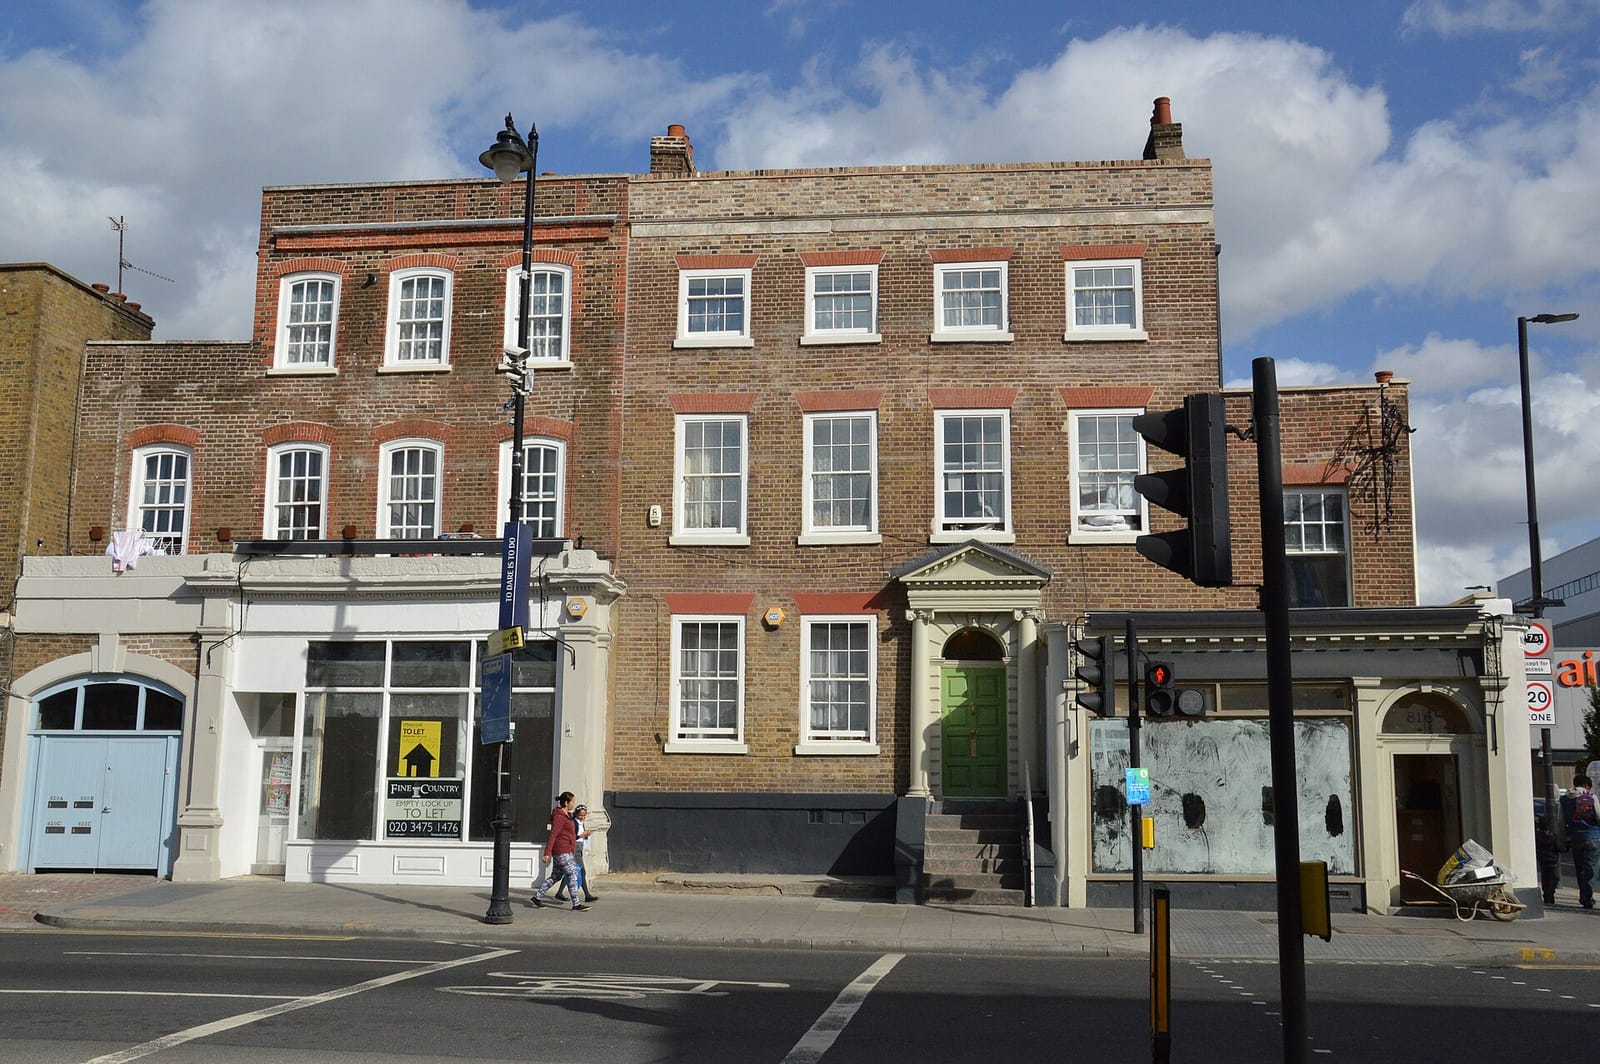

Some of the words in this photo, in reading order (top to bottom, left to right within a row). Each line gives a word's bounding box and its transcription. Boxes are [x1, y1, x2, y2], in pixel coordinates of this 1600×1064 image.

[508, 537, 516, 549] DO
[508, 550, 515, 560] TO
[507, 561, 515, 569] IS
[506, 570, 514, 591] DARE
[505, 592, 513, 602] TO
[1555, 649, 1600, 688] ai
[1527, 691, 1548, 703] 20
[1529, 713, 1552, 721] ONE
[390, 783, 413, 795] FINE
[420, 783, 460, 795] COUNTRY
[421, 800, 441, 808] LOCK
[443, 800, 454, 808] UP
[403, 808, 422, 819] TO
[425, 808, 447, 819] LET
[388, 821, 408, 832] 020
[410, 821, 433, 833] 3475
[437, 822, 459, 833] 1476
